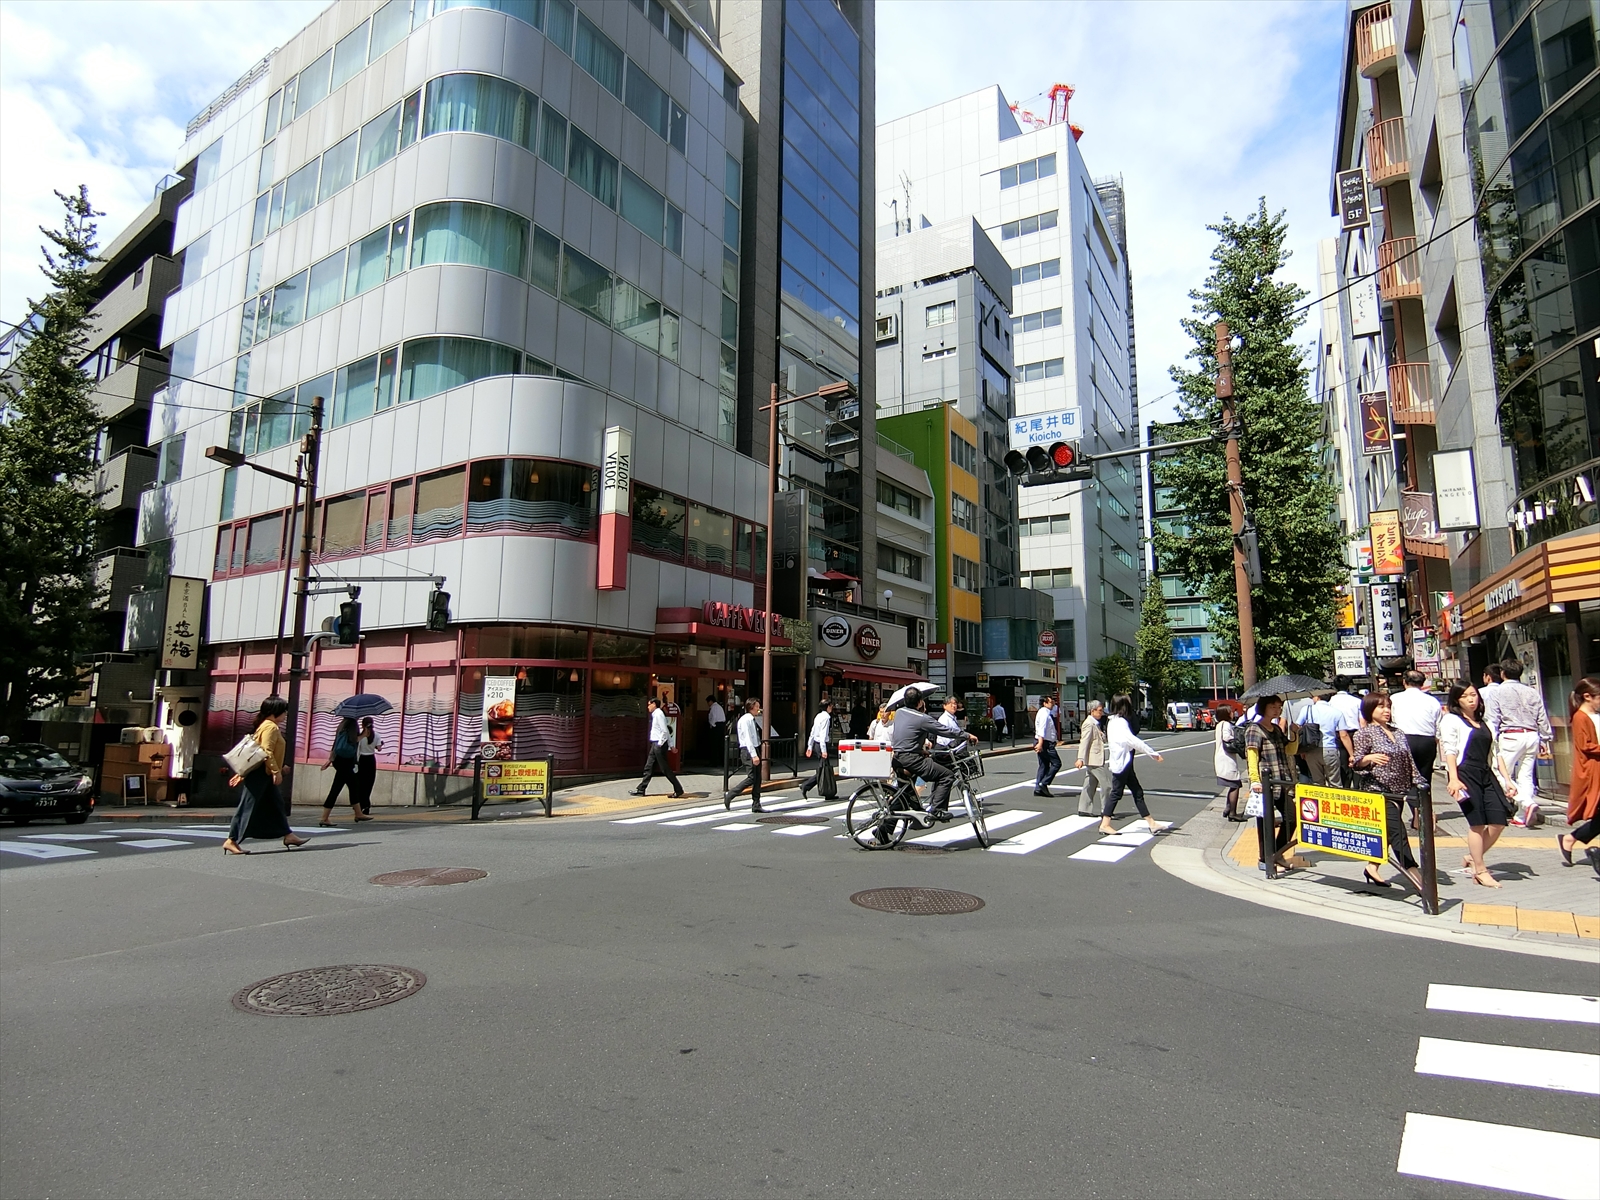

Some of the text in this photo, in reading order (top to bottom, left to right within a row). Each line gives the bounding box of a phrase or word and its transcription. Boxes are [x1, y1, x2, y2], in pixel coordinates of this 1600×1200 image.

[1347, 208, 1363, 220] 5F
[1015, 412, 1075, 434] 紀尾井町
[1029, 430, 1062, 443] Kioicho
[604, 451, 617, 490] VELOCE
[617, 455, 629, 492] VELOCE
[787, 492, 799, 518] Kioi
[1403, 506, 1429, 535] Stage
[1421, 520, 1436, 538] 31
[1376, 533, 1387, 566] ダイニング
[1380, 588, 1395, 643] 立喰い寿司
[169, 620, 195, 658] 塩梅
[861, 636, 881, 647] DINER
[504, 768, 545, 777] 路上喫煙禁止
[1321, 800, 1382, 822] 路上喫煙禁止
[1331, 828, 1343, 836] fine
[1350, 832, 1366, 841] 2000
[1366, 836, 1378, 844] yen
